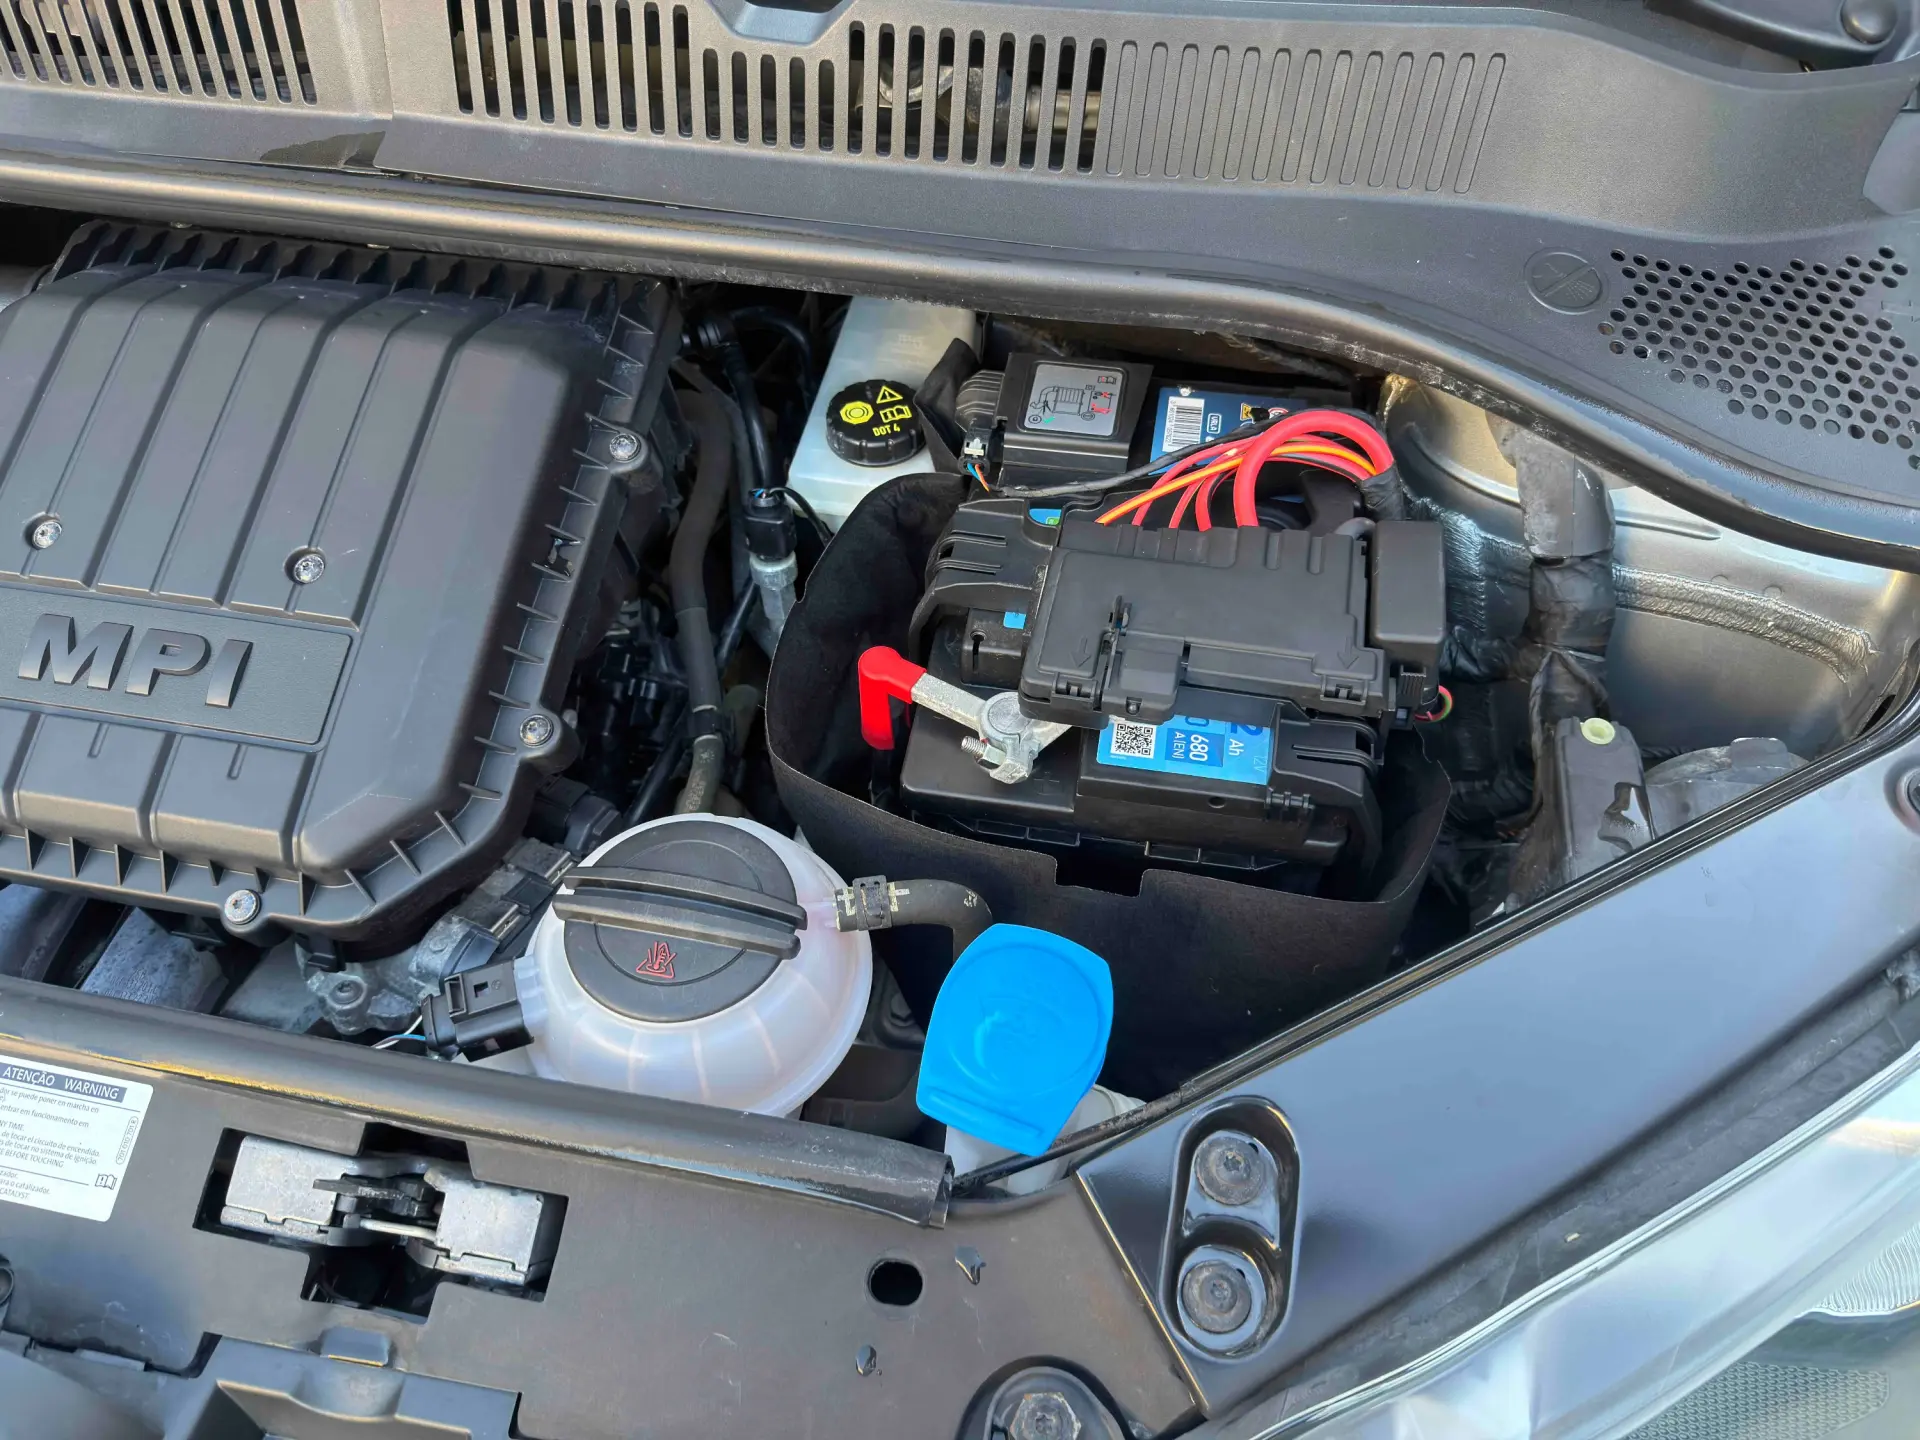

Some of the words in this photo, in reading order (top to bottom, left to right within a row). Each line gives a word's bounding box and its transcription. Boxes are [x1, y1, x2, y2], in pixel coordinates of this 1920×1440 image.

[872, 424, 892, 437] DOT
[893, 423, 901, 433] 4
[18, 613, 254, 708] MPI
[1174, 731, 1183, 740] A
[1189, 734, 1208, 762] 680
[1228, 738, 1245, 757] Ah
[1253, 755, 1268, 773] 12V
[3, 1066, 55, 1087] ATENÇÃO
[64, 1078, 119, 1100] WARNING
[18, 1090, 38, 1100] puede
[38, 1095, 57, 1104] poner
[66, 1101, 90, 1112] marcha
[31, 1109, 78, 1126] funcionamento
[1, 1130, 9, 1138] de
[11, 1132, 27, 1141] tocar
[34, 1137, 57, 1148] circuito
[57, 1142, 66, 1150] de
[5, 1149, 28, 1160] BEFORE
[14, 1141, 30, 1151] tocar
[41, 1148, 64, 1158] sistema
[65, 1152, 73, 1160] de
